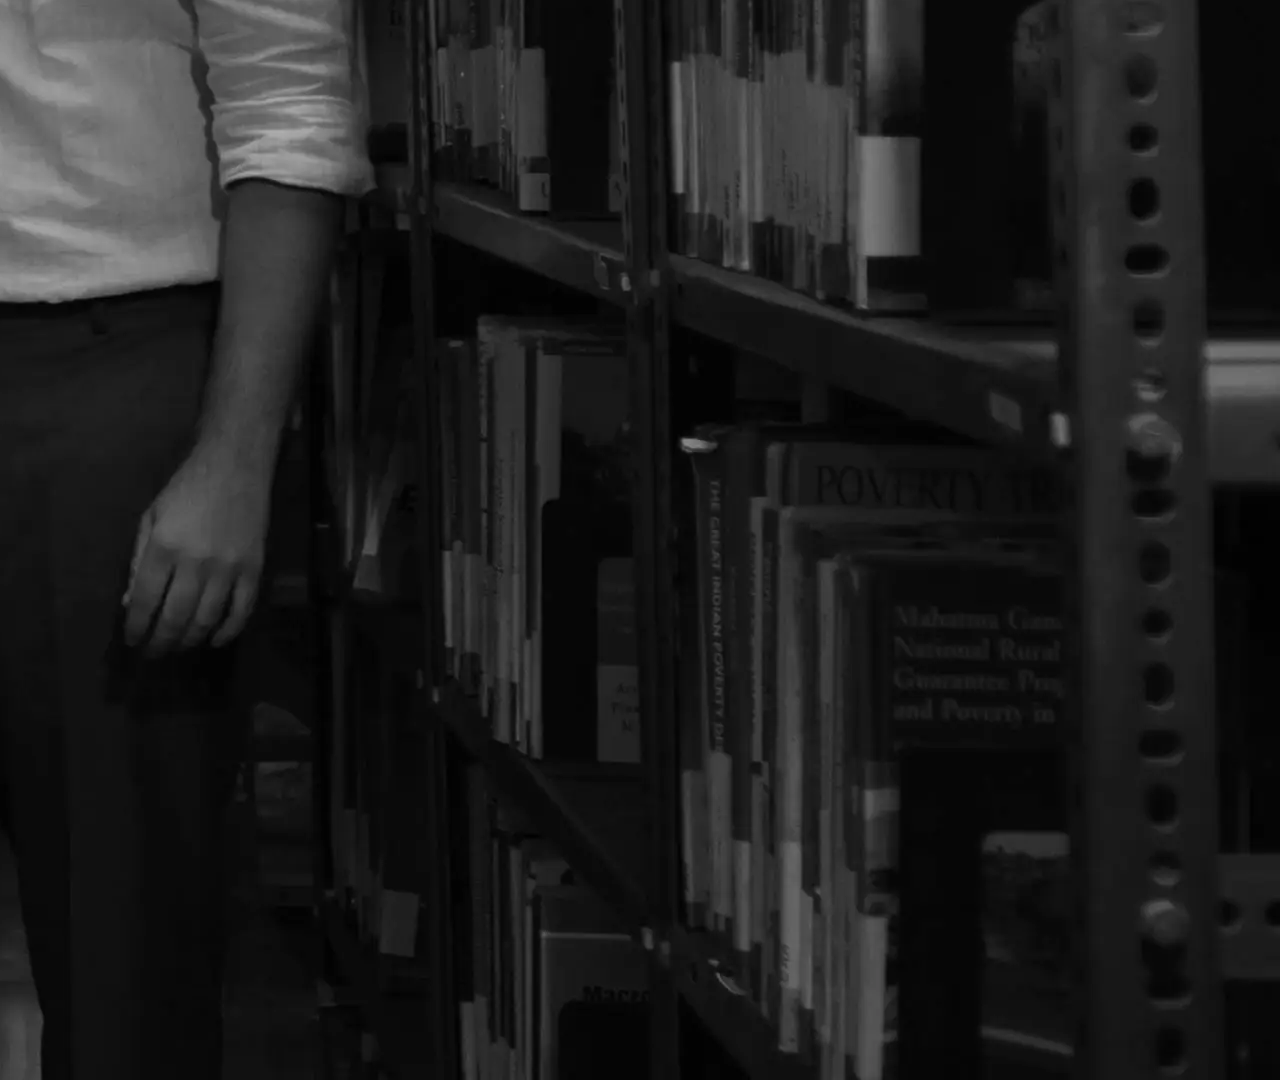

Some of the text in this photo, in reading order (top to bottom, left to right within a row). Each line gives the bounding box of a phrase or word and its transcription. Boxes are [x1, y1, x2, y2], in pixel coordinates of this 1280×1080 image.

[815, 465, 990, 513] POVERTY
[709, 516, 721, 570] GREAT
[711, 575, 722, 637] INDIAN
[893, 635, 1062, 662] National Rural
[711, 642, 724, 718] POVERTY
[892, 666, 1011, 691] Guarantee
[893, 697, 1057, 731] and Poverty in
